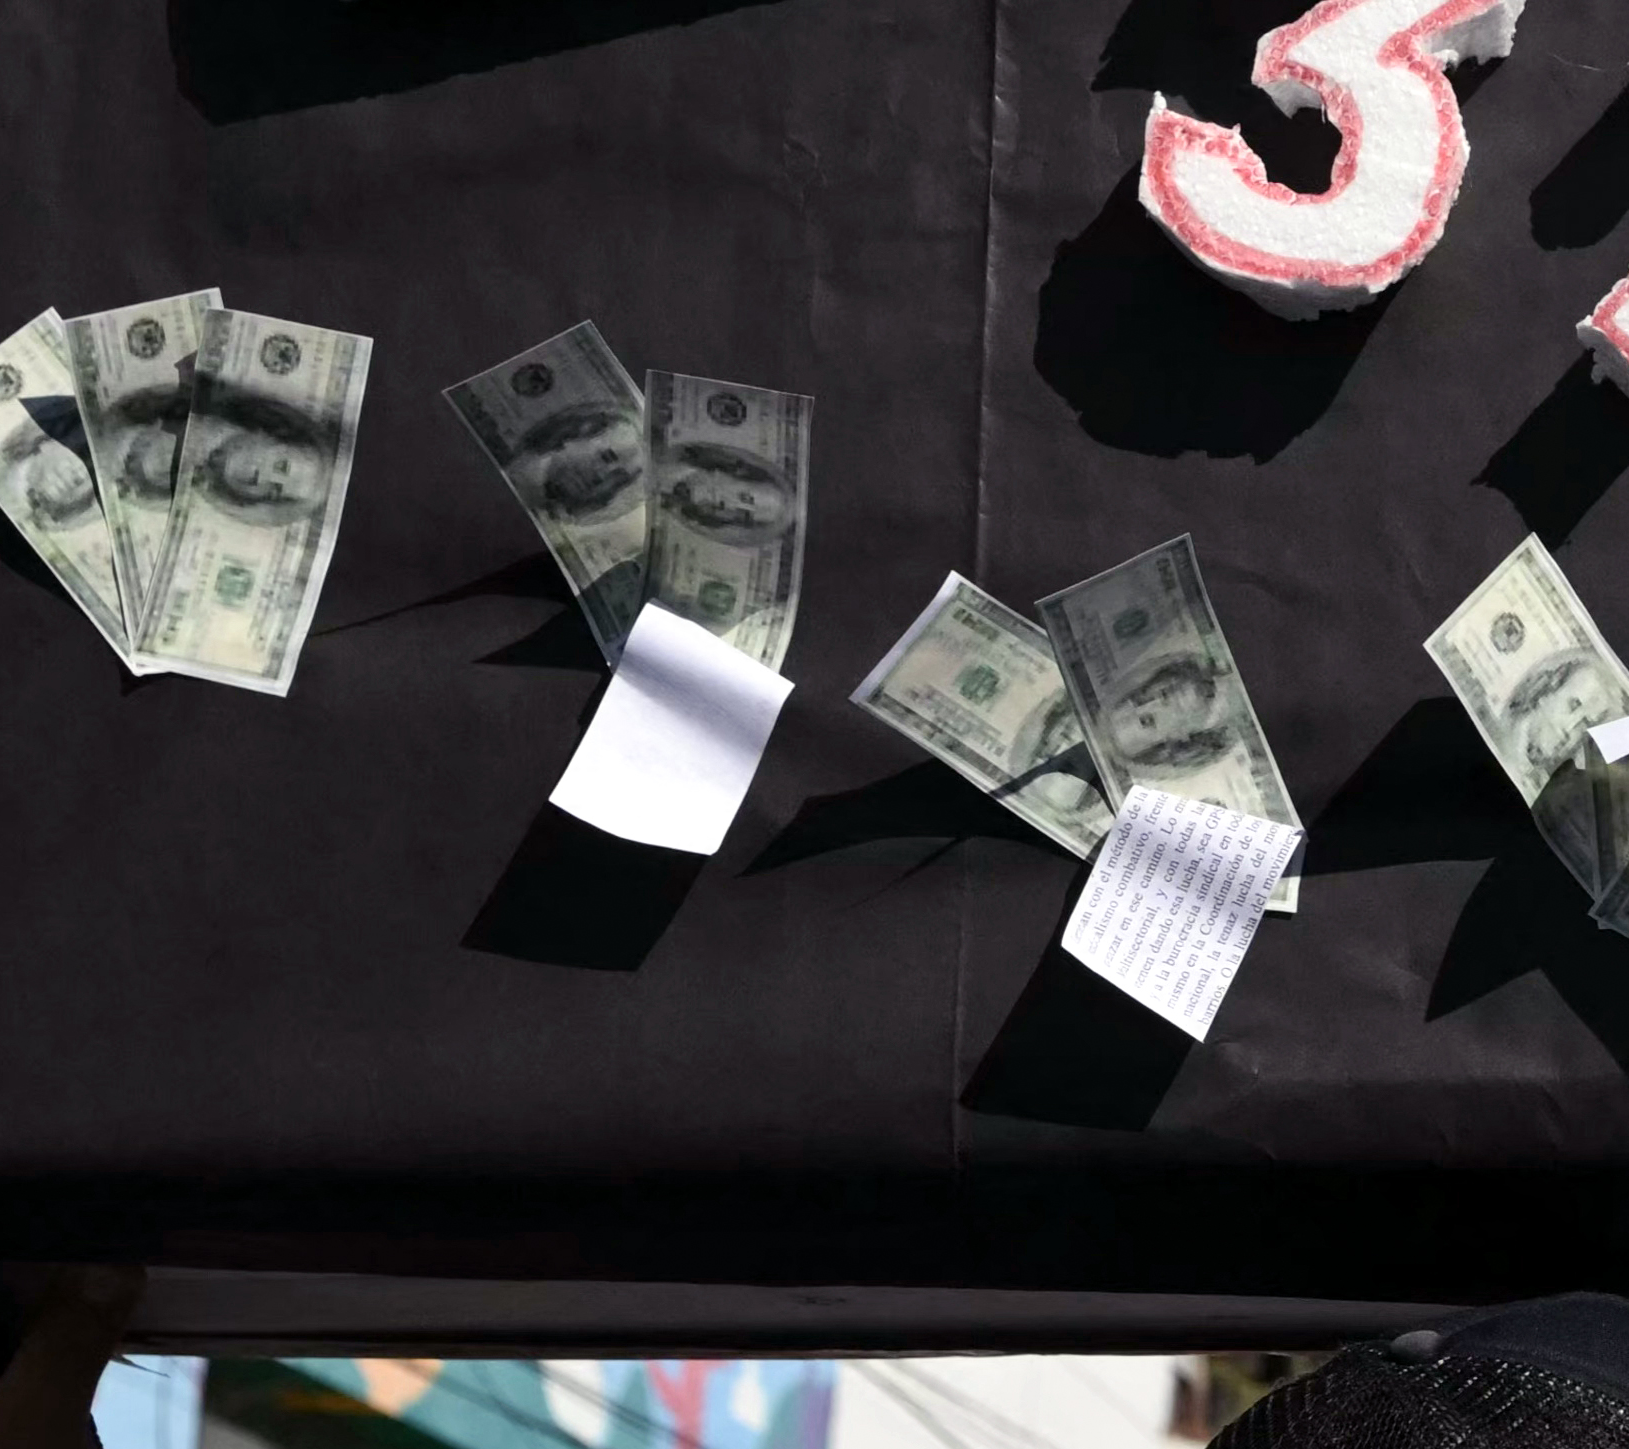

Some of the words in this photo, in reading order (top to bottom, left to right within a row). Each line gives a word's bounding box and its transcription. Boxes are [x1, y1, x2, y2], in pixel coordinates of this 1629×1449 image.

[1133, 792, 1148, 802] la
[1126, 804, 1141, 820] de
[1107, 822, 1132, 868] método
[1197, 833, 1212, 853] sea
[1238, 835, 1253, 850] de
[1115, 831, 1152, 897] combativo,
[1120, 916, 1132, 931] en
[1129, 892, 1143, 912] ese
[1140, 842, 1167, 888] camino.
[1160, 817, 1177, 835] Lo
[1156, 888, 1168, 900] y
[1163, 860, 1180, 883] con
[1175, 822, 1196, 853] todas
[1176, 857, 1203, 892] lucha,
[1099, 869, 1111, 883] el
[1089, 886, 1104, 908] con
[1155, 969, 1170, 981] la
[1163, 905, 1200, 966] burocracia
[1196, 852, 1223, 901] sindical
[1219, 835, 1232, 850] en
[1169, 896, 1184, 916] esa
[1199, 854, 1243, 935] Coordinación
[1250, 892, 1267, 913] del
[1149, 918, 1173, 953] dando
[1183, 968, 1215, 1016] nacional,
[1206, 950, 1221, 961] la
[1217, 912, 1238, 945] tenaz
[1231, 874, 1255, 907] lucha
[1250, 848, 1267, 868] del
[1191, 939, 1205, 950] la
[1233, 917, 1260, 950] lucha
[1186, 953, 1199, 967] en
[1220, 967, 1233, 978] O
[1226, 954, 1241, 965] la
[1167, 970, 1190, 1008] mismo
[1198, 985, 1227, 1025] barrios.
